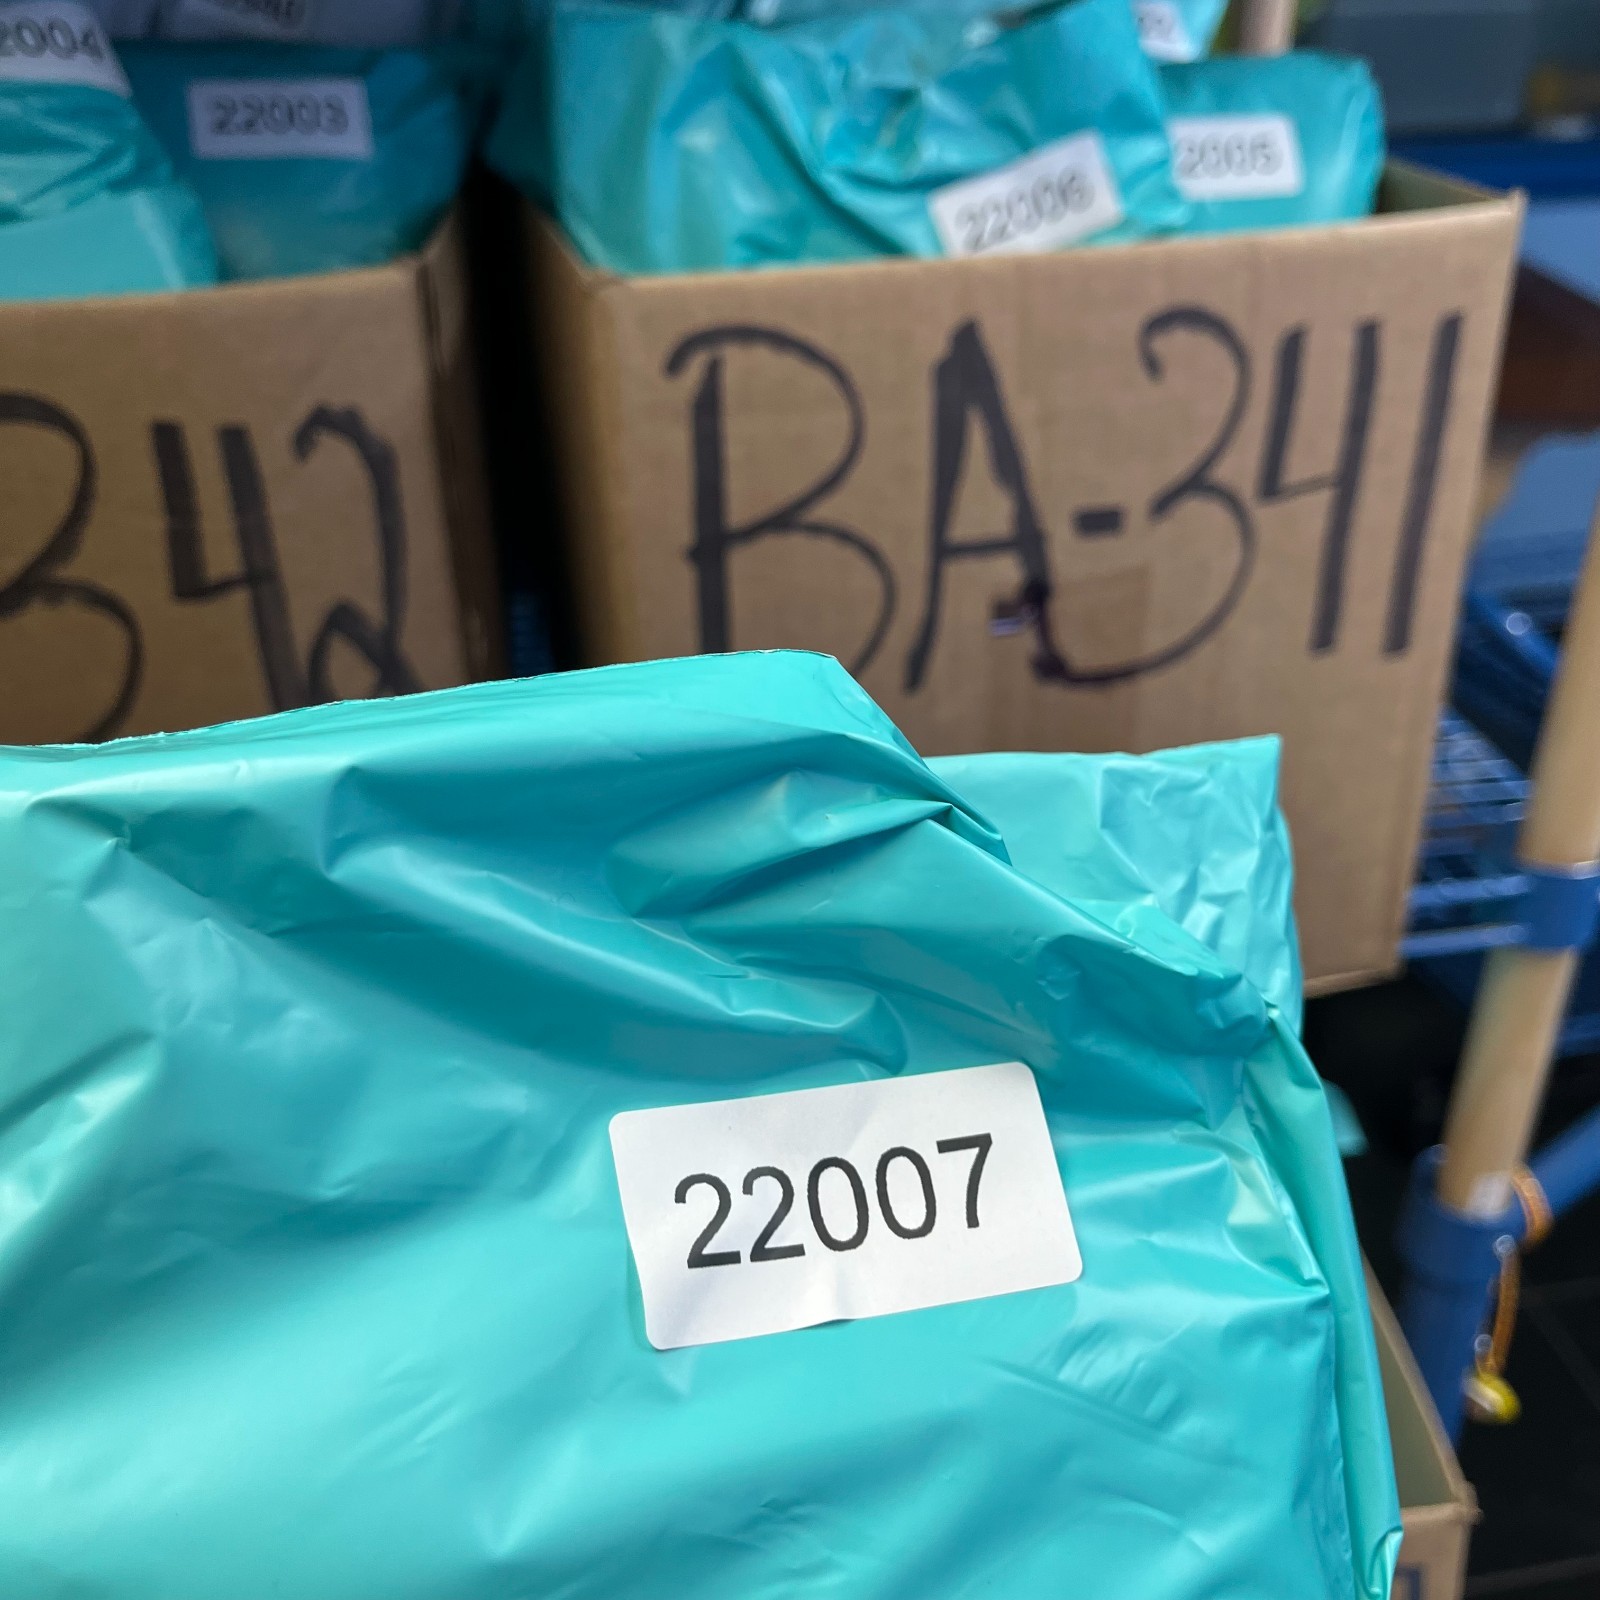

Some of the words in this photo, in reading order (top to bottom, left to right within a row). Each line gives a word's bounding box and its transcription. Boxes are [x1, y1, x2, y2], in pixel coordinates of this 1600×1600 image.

[210, 93, 349, 136] 22003
[955, 163, 1096, 253] 22006
[664, 304, 1464, 694] BA-341
[674, 1132, 993, 1269] 22007
